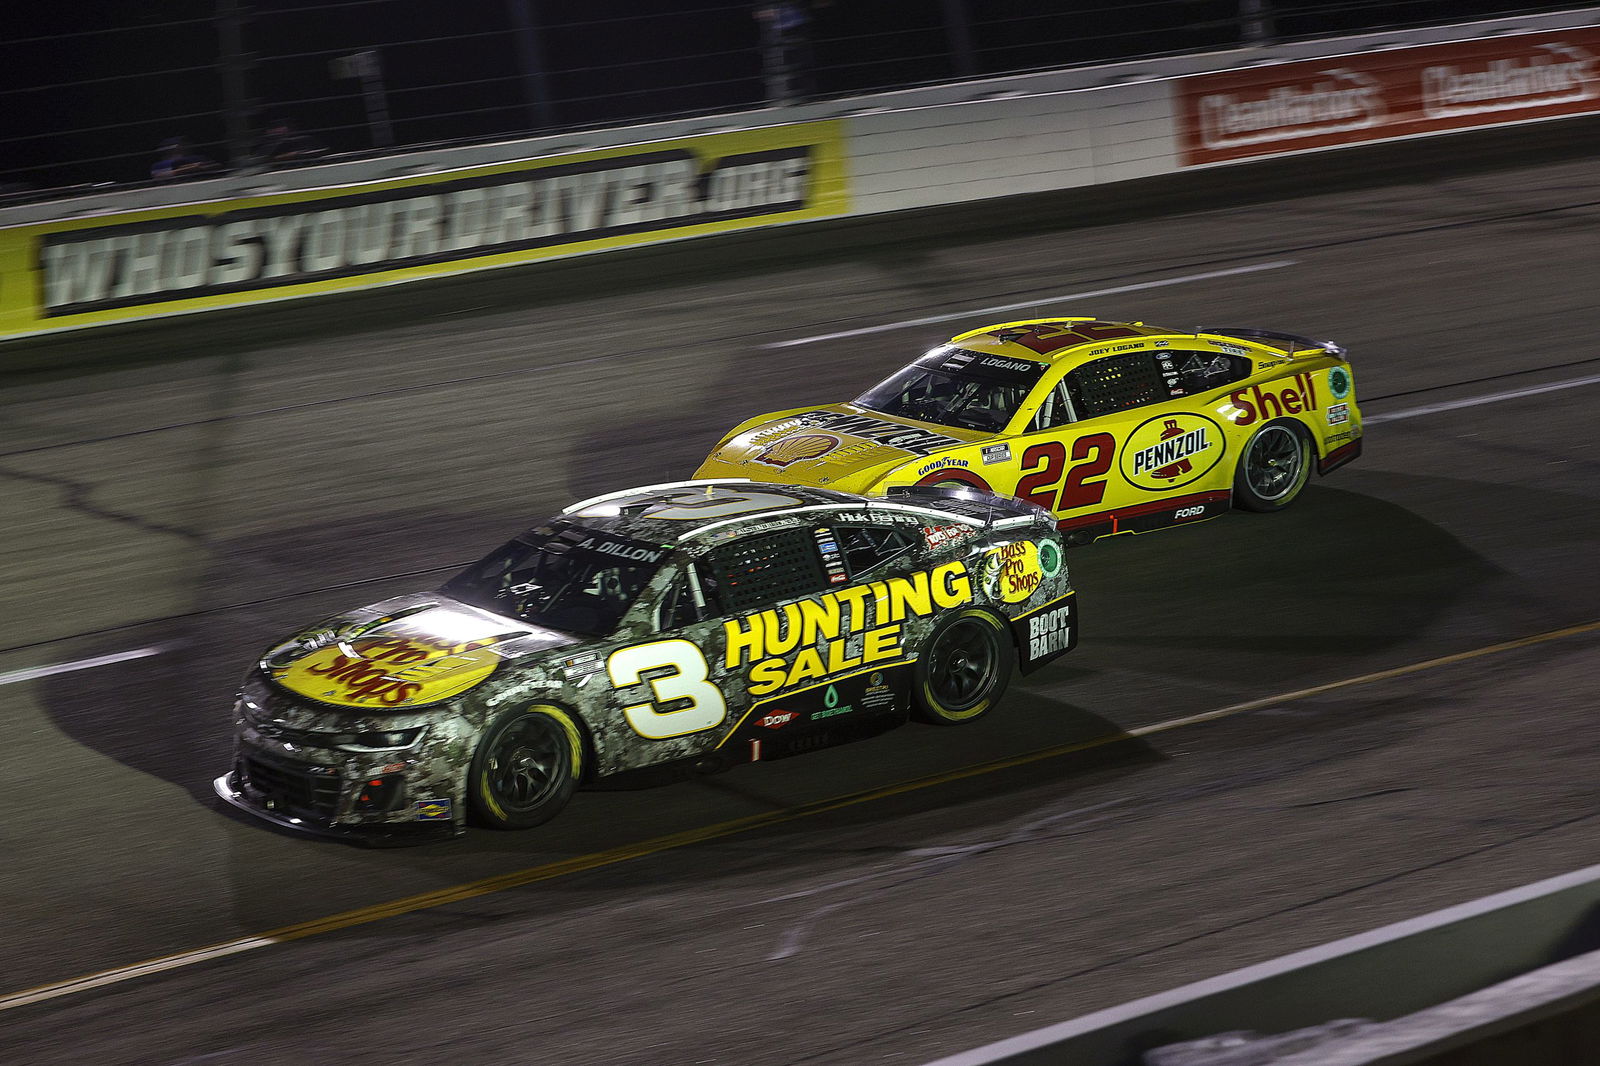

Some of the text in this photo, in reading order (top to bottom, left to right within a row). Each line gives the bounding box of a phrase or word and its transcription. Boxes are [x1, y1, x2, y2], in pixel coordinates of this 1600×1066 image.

[1088, 347, 1110, 357] JOEY
[1112, 342, 1145, 352] LOGANO
[979, 358, 1031, 372] LOGANO
[1231, 371, 1318, 426] Shell
[1133, 427, 1209, 477] PENNZOIL
[1014, 432, 1117, 512] 22
[838, 512, 919, 525] Huk Fishing
[1174, 505, 1205, 519] FORD
[577, 538, 663, 564] A. DILLON
[1001, 540, 1026, 559] Bass
[1005, 558, 1024, 576] Pro
[1008, 571, 1038, 594] Shops
[723, 560, 973, 670] HUNTING
[1029, 605, 1069, 640] BOOT
[1029, 626, 1071, 661] BARN
[747, 623, 904, 697] SALE
[606, 639, 728, 741] 3
